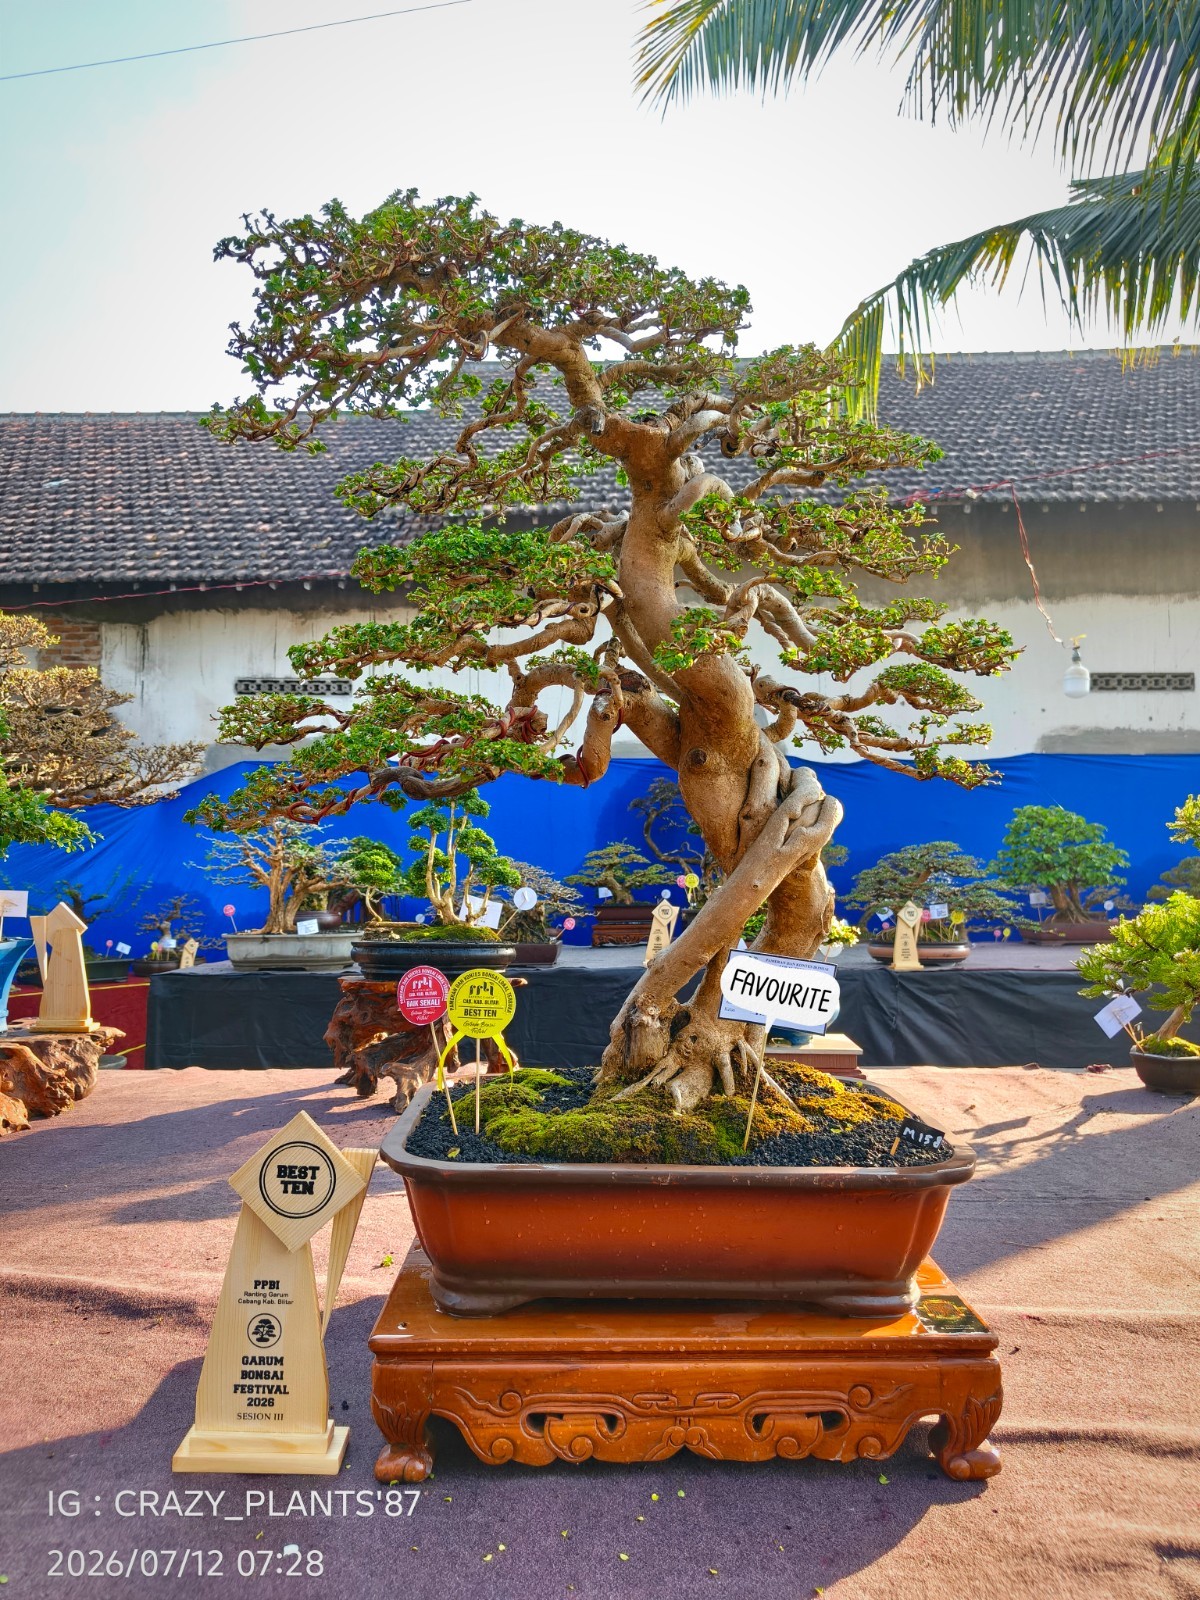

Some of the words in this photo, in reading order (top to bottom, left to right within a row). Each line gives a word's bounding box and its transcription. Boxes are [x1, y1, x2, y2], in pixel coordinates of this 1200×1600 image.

[406, 1000, 418, 1008] BAIK
[420, 998, 440, 1006] SEKALI
[463, 1008, 482, 1016] BEST
[483, 1009, 497, 1017] TEN
[276, 1164, 320, 1180] BEST
[280, 1180, 315, 1195] TEN
[253, 1279, 280, 1290] PPBI
[241, 1355, 284, 1366] GARUM
[240, 1370, 284, 1380] BONSAI
[233, 1383, 290, 1395] FESTIVAL
[246, 1397, 275, 1407] 2026
[236, 1412, 272, 1421] SESION
[273, 1413, 284, 1421] III
